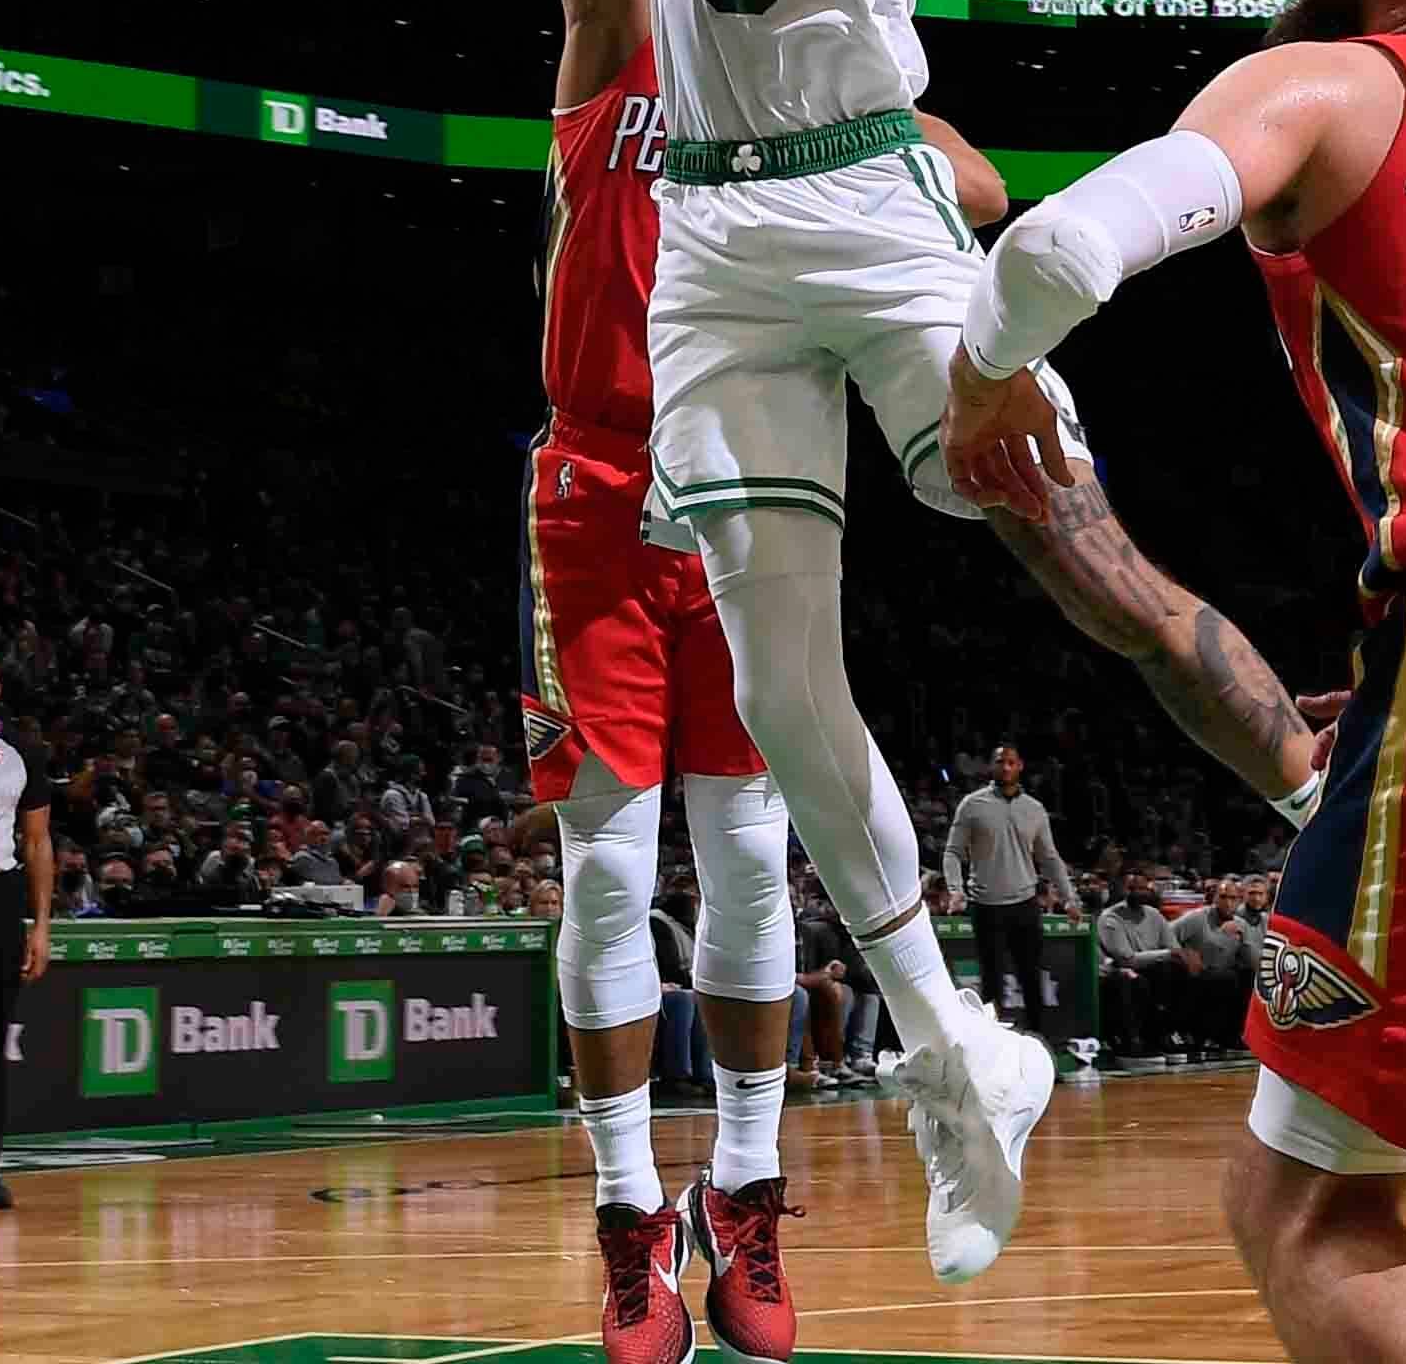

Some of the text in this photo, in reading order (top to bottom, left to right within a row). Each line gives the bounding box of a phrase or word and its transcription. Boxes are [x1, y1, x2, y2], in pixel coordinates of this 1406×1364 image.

[263, 99, 388, 140] TD Bank
[86, 1000, 281, 1074] TD Bank
[333, 992, 499, 1061] TD Bank
